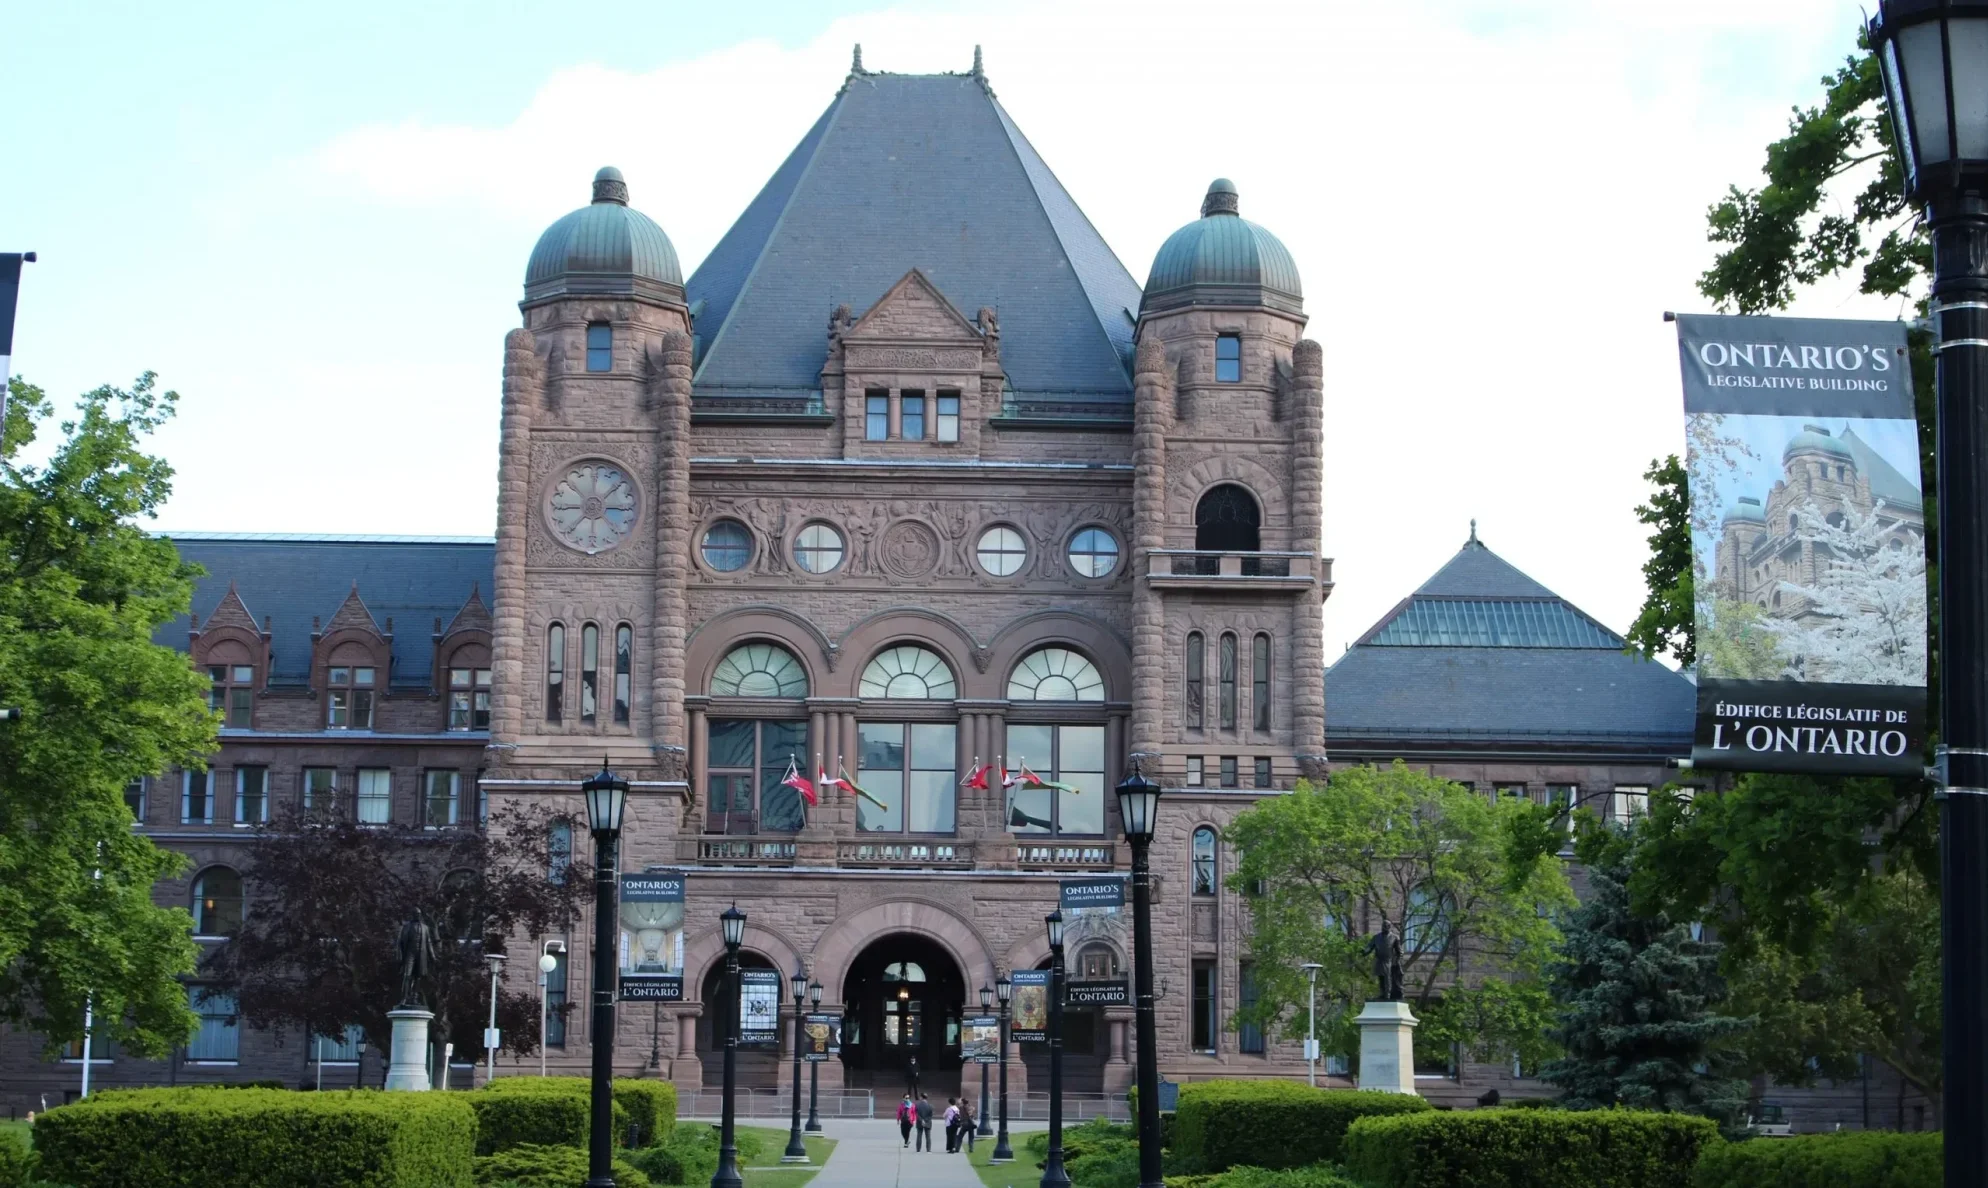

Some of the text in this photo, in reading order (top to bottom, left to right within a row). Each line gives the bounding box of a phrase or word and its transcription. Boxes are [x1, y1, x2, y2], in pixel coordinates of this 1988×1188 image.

[1700, 342, 1890, 372] ONTARIO'S
[1707, 374, 1888, 392] LEGISLATIVE BUILDING
[1715, 700, 1908, 723] ÉDIFICE LÉGISLATIF DE
[1711, 721, 1907, 757] L'ONTARIO
[626, 880, 680, 889] ONTARIO'S
[1065, 884, 1119, 895] ONTARIO'S
[623, 987, 679, 997] L'ONTARIO
[1070, 991, 1125, 1001] L'ONTARIO
